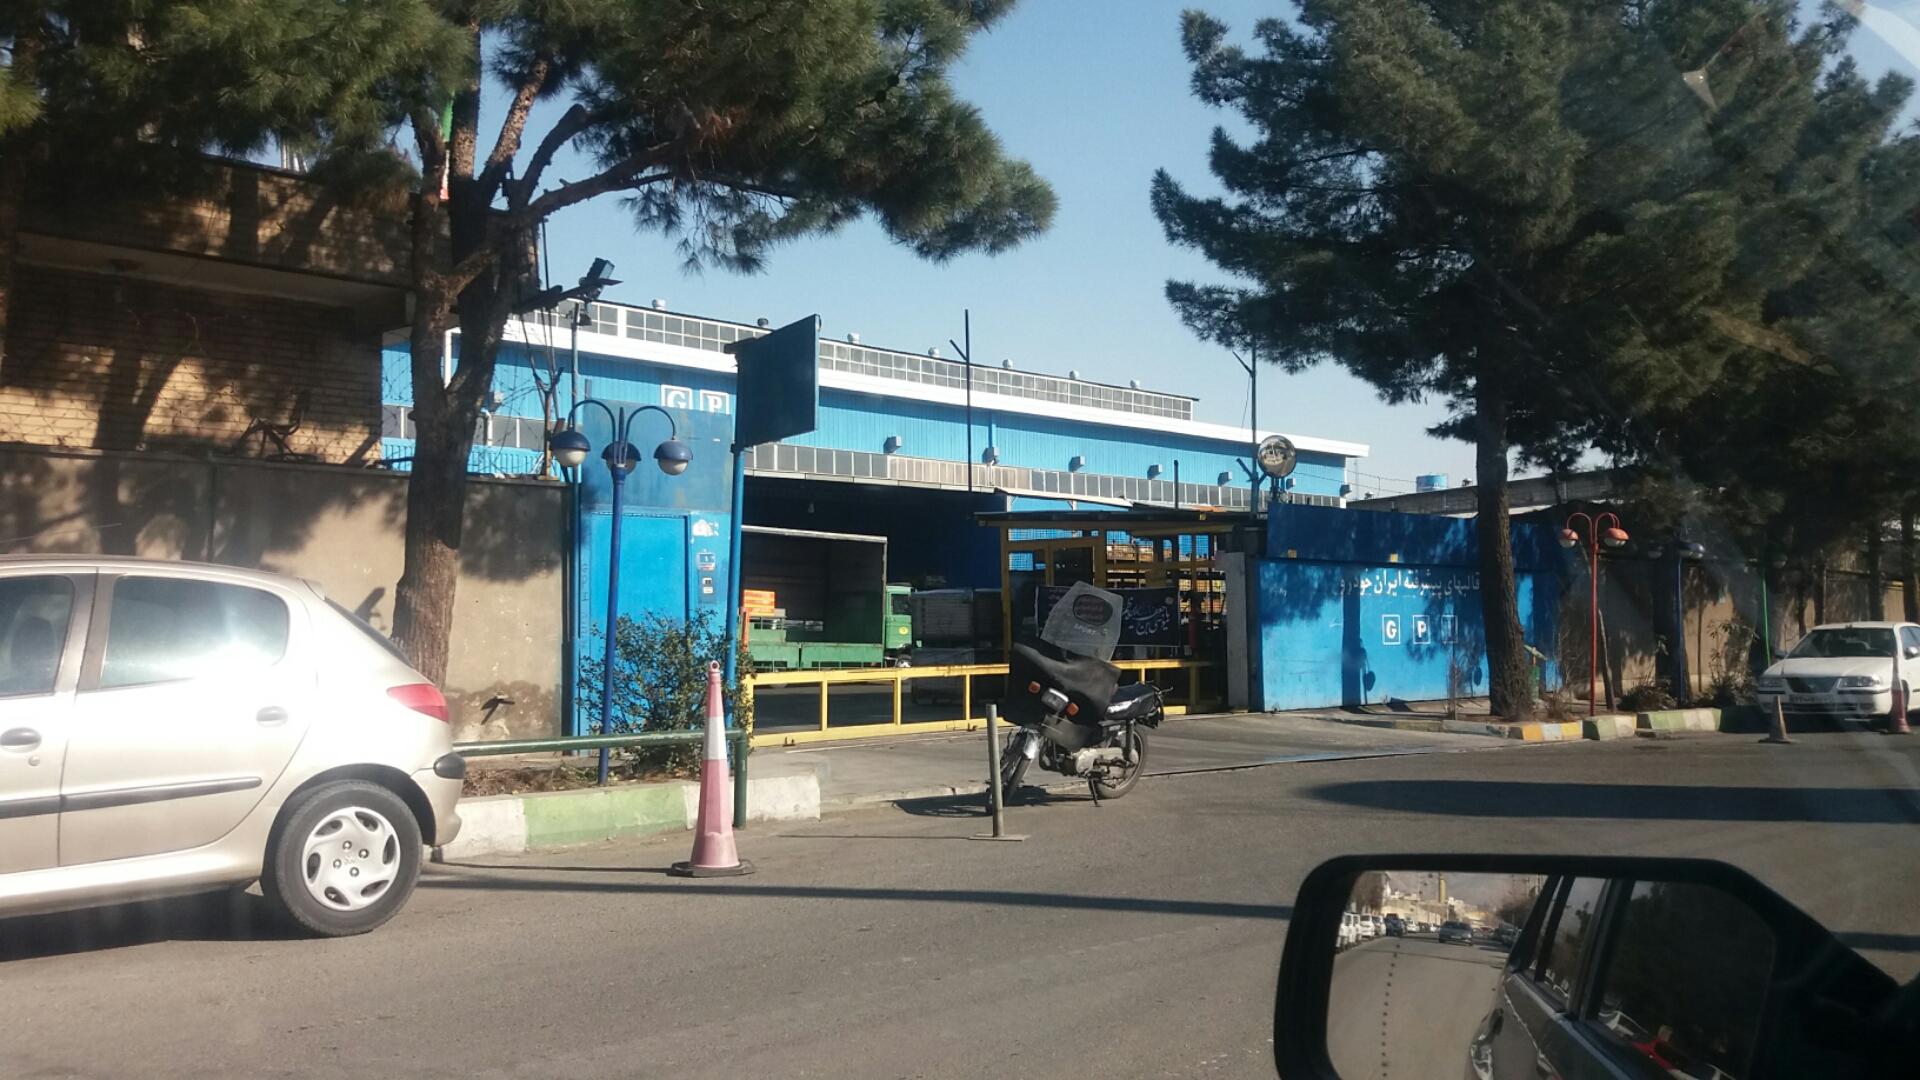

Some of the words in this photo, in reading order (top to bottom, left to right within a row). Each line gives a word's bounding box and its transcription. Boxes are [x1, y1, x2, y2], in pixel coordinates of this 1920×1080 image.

[1339, 568, 1373, 596] خودرو
[1374, 569, 1402, 597] ایران
[1403, 569, 1442, 599] پیشرفته
[1444, 571, 1480, 597] قالبهای
[1386, 620, 1397, 639] G
[1417, 620, 1427, 638] P
